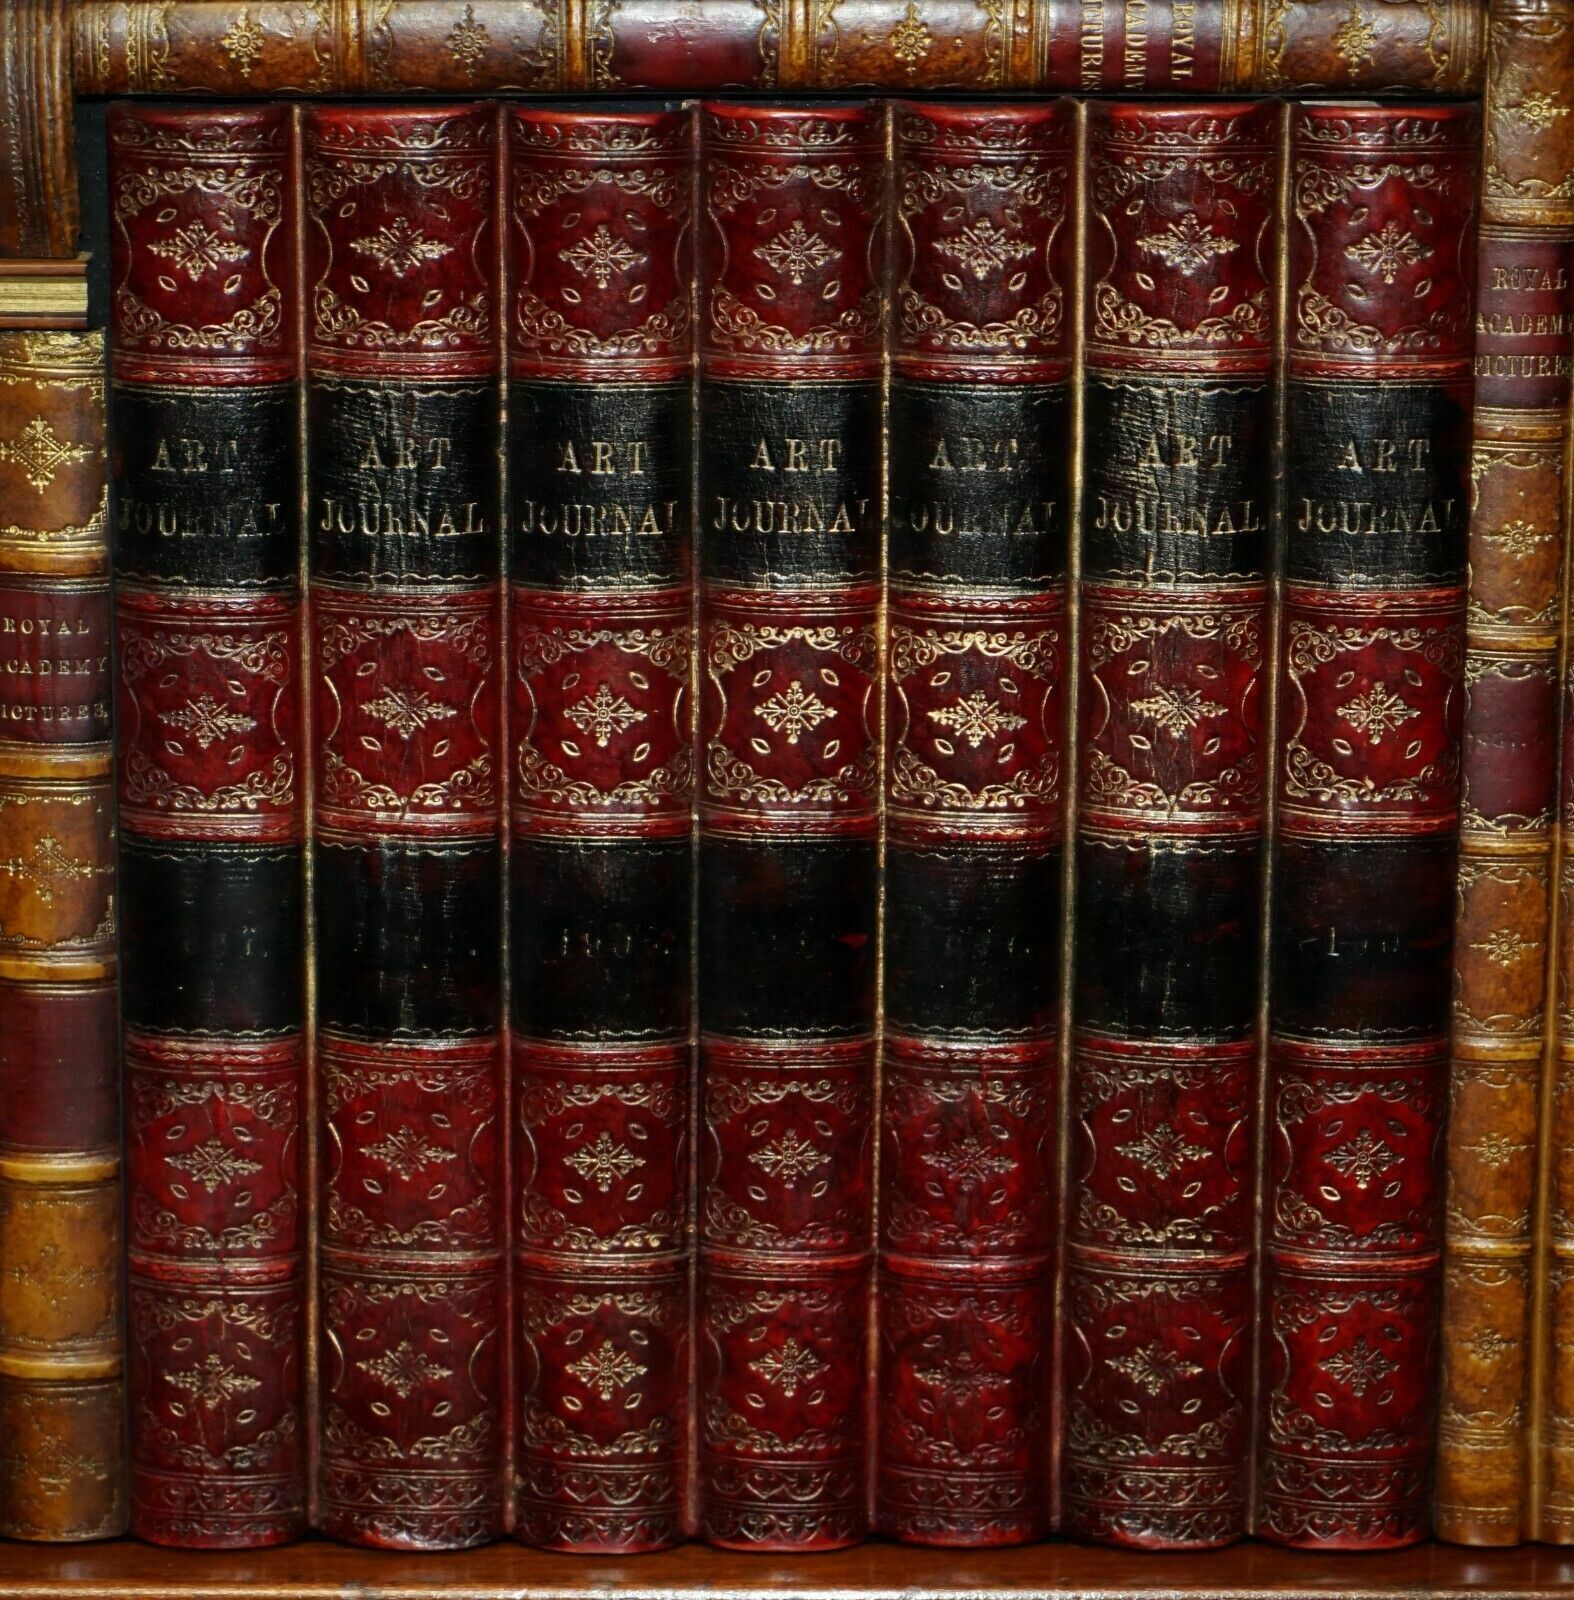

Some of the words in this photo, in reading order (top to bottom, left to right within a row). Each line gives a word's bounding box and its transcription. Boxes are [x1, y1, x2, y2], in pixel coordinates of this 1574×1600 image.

[1080, 0, 1105, 91] ICTURES
[1124, 0, 1148, 91] CADEMY
[1171, 1, 1195, 81] ROYAL
[1492, 267, 1567, 291] ROYAL
[1474, 355, 1569, 378] PICTURE
[151, 438, 238, 472] ART
[360, 437, 450, 470] ART
[557, 440, 647, 474] ART
[750, 437, 842, 472] ART
[929, 437, 1018, 472] ART
[1139, 433, 1233, 468] ART
[1337, 438, 1430, 474] ART
[321, 498, 484, 537] JOURNAL
[896, 498, 1057, 536] OURNA
[3, 617, 90, 635] ROYAL
[0, 656, 108, 676] CADEMY
[2, 704, 109, 722] ICTURES
